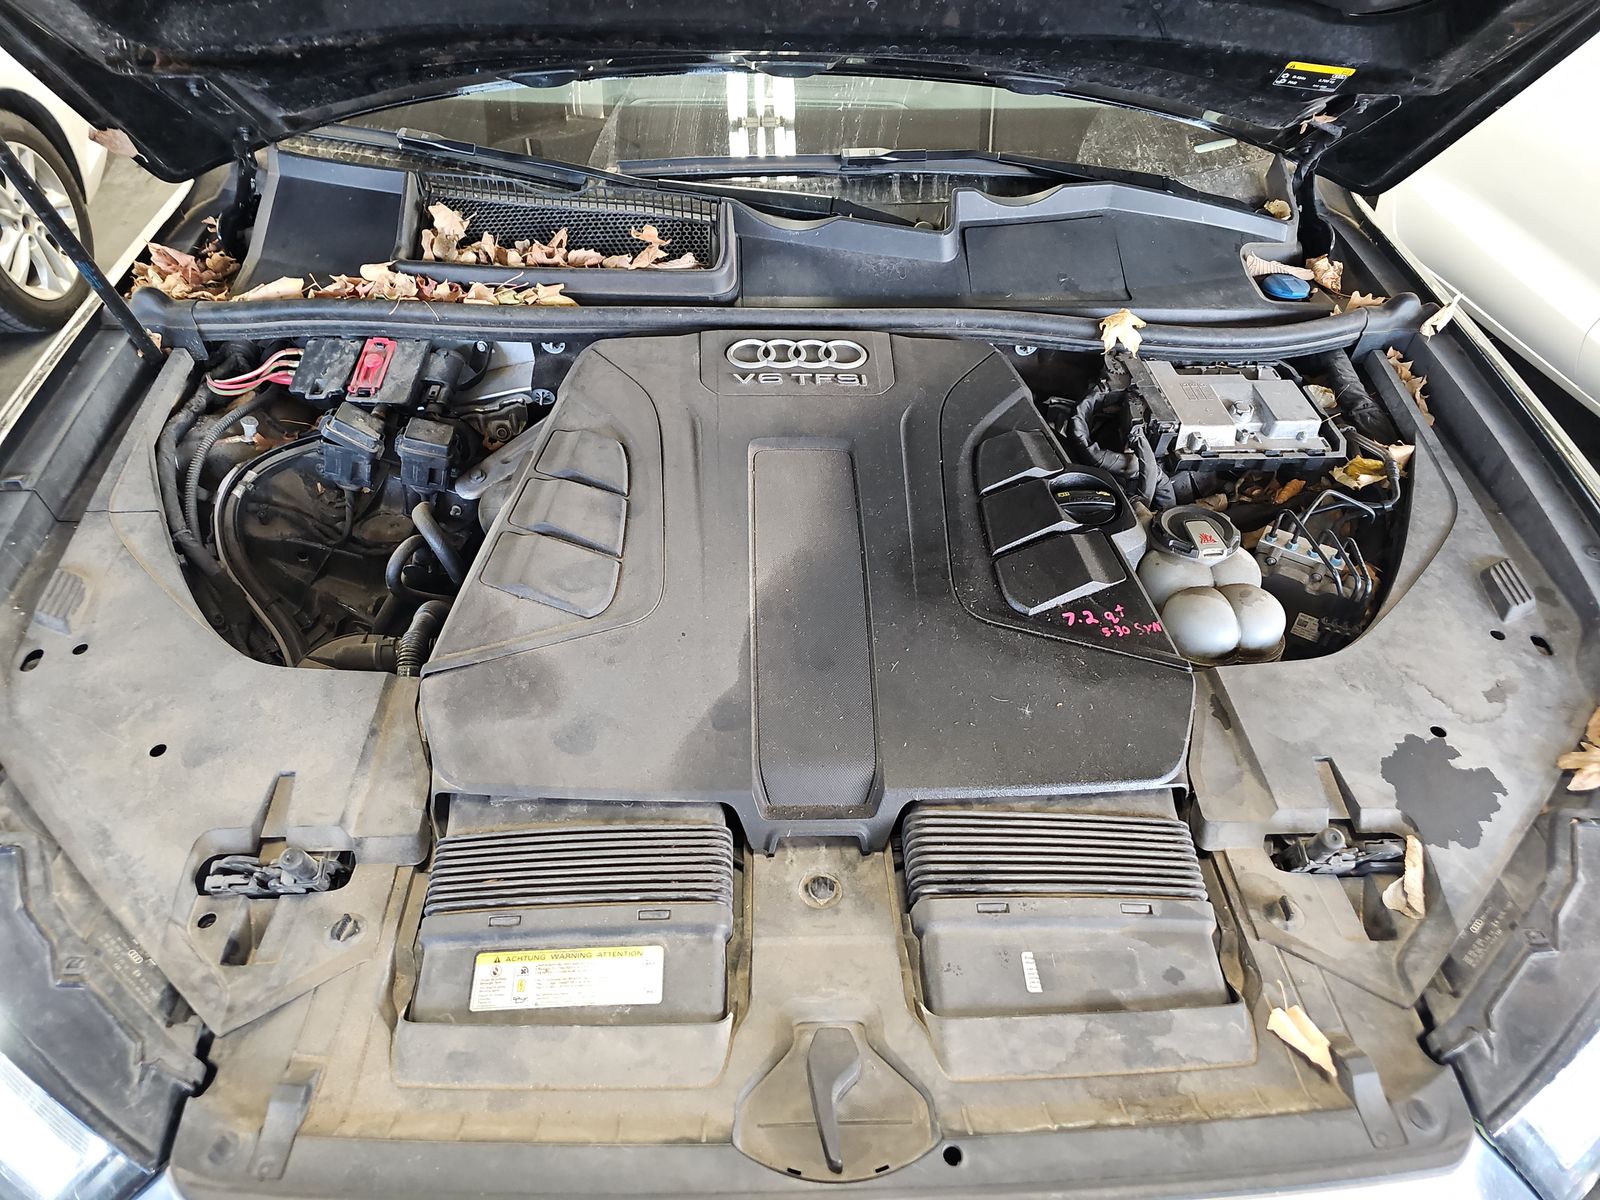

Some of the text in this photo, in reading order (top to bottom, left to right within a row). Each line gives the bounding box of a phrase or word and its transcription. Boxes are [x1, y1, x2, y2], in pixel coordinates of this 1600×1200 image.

[732, 373, 868, 386] V6 TFSI
[1061, 610, 1099, 626] 7.2
[505, 950, 643, 962] ACHTUNG WARNING ATTENTION
